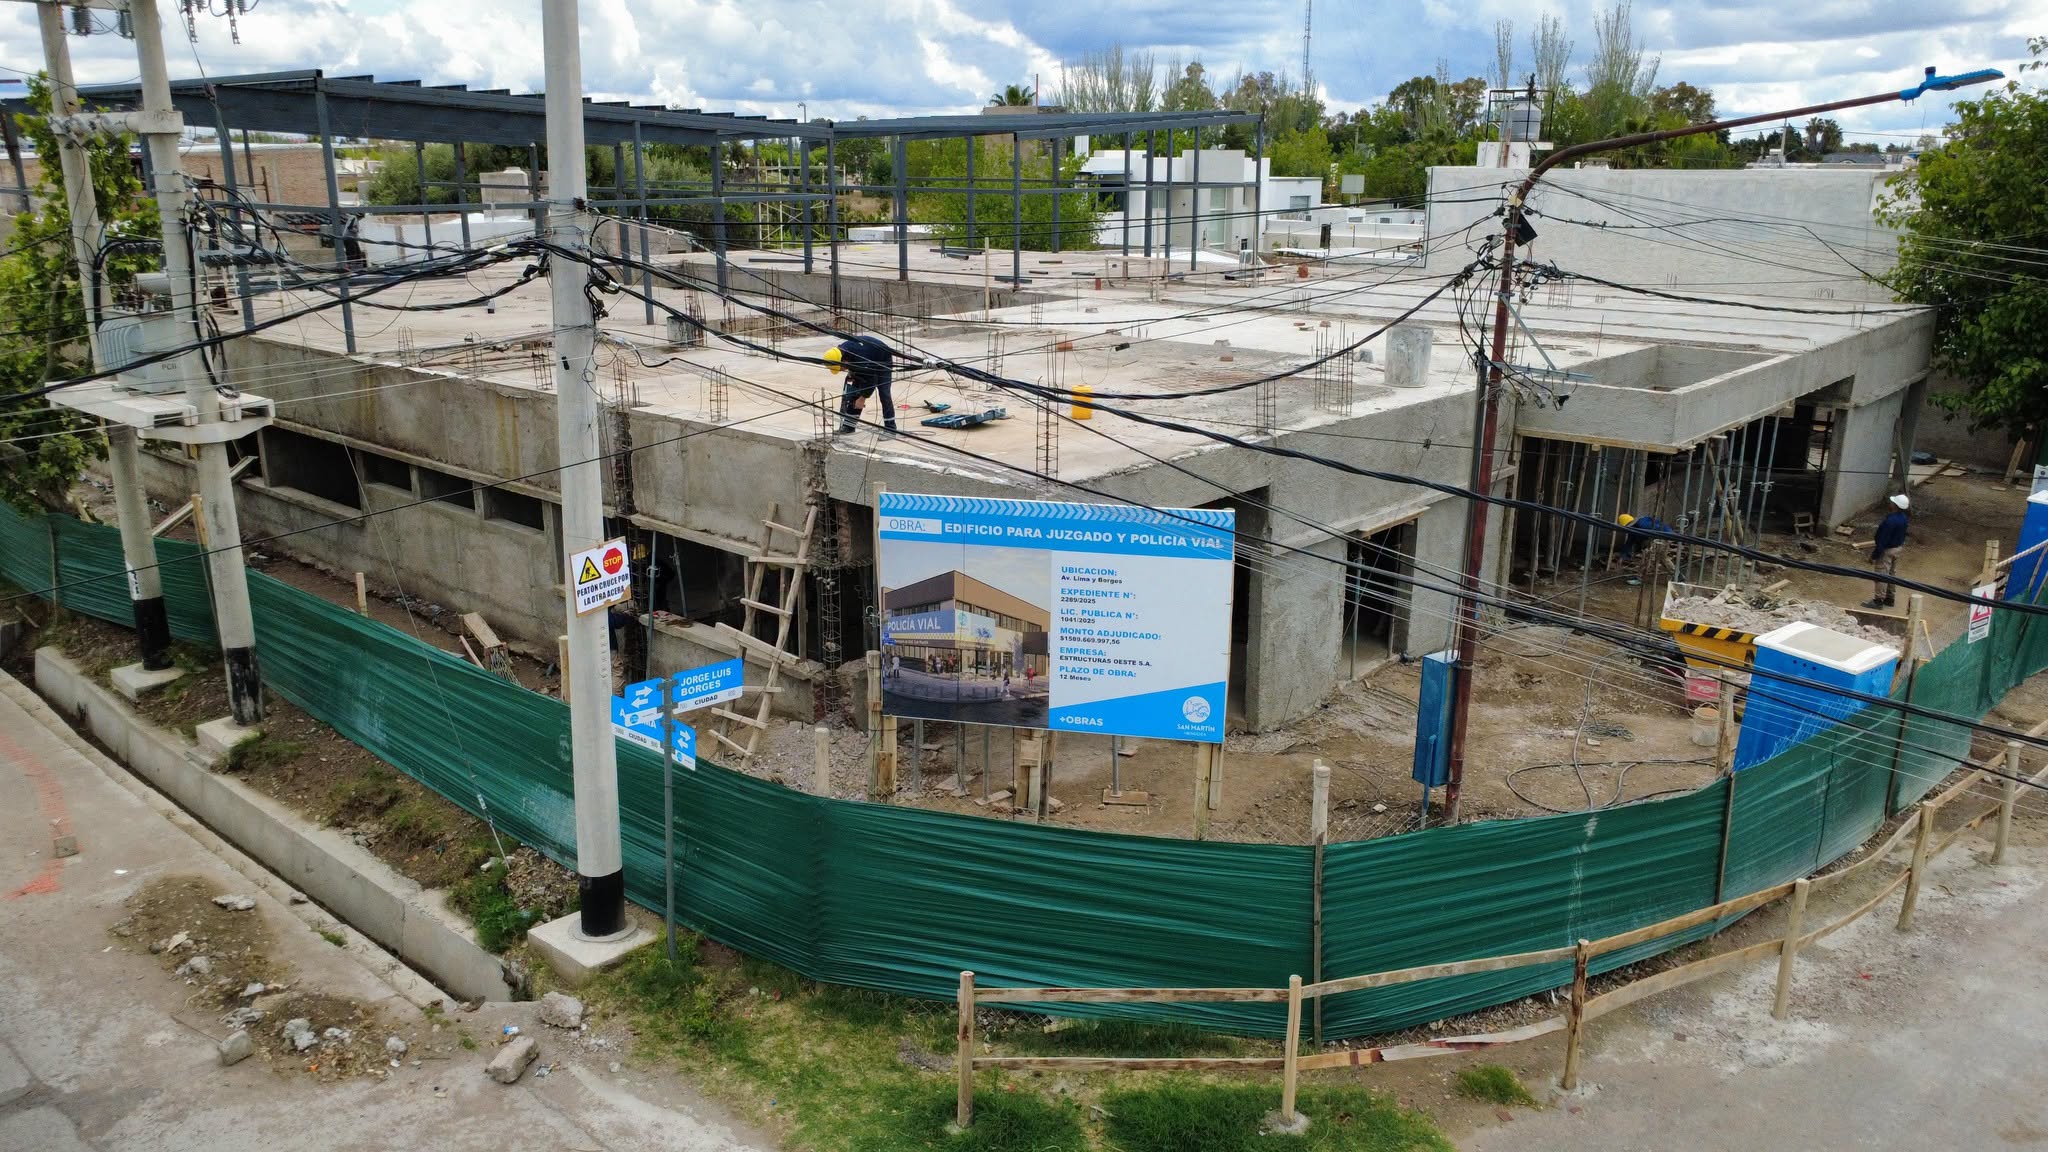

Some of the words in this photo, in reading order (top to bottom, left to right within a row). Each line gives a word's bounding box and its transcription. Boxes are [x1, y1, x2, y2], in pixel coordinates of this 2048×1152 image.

[889, 519, 926, 532] OBRA:
[944, 523, 1003, 536] EDIFICIO
[1006, 527, 1043, 538] PARA
[1045, 529, 1113, 542] JUZGADO
[1116, 533, 1127, 543] Y
[1130, 534, 1187, 547] POLICIA
[1191, 538, 1224, 549] VIAL
[603, 555, 622, 567] STOP
[1061, 566, 1117, 576] UBICACION:
[599, 576, 618, 590] CRUCE
[617, 573, 629, 583] POR
[583, 597, 591, 606] LA
[591, 591, 607, 603] OTRA
[606, 585, 625, 598] ACERA
[1061, 588, 1120, 598] EXPEDIENTE
[1061, 608, 1079, 616] LIC.
[1081, 609, 1122, 619] PUBLICA
[887, 617, 915, 631] POLICÍA
[917, 617, 941, 630] VIAL
[1060, 627, 1094, 636] MONTO
[1096, 630, 1162, 640] ADJUDICADO:
[1059, 646, 1107, 657] EMPRESA:
[1059, 655, 1111, 664] ESTRUCTURAS
[1113, 658, 1137, 666] OESTE
[680, 672, 710, 687] JORGE
[711, 667, 732, 680] LUIS
[1059, 665, 1090, 674] PLAZO
[1107, 669, 1137, 678] OBRA:
[680, 679, 721, 697] BORGES
[694, 694, 719, 705] CIUDAD
[1177, 723, 1190, 731] SAN
[628, 732, 648, 744] CIUDAD
